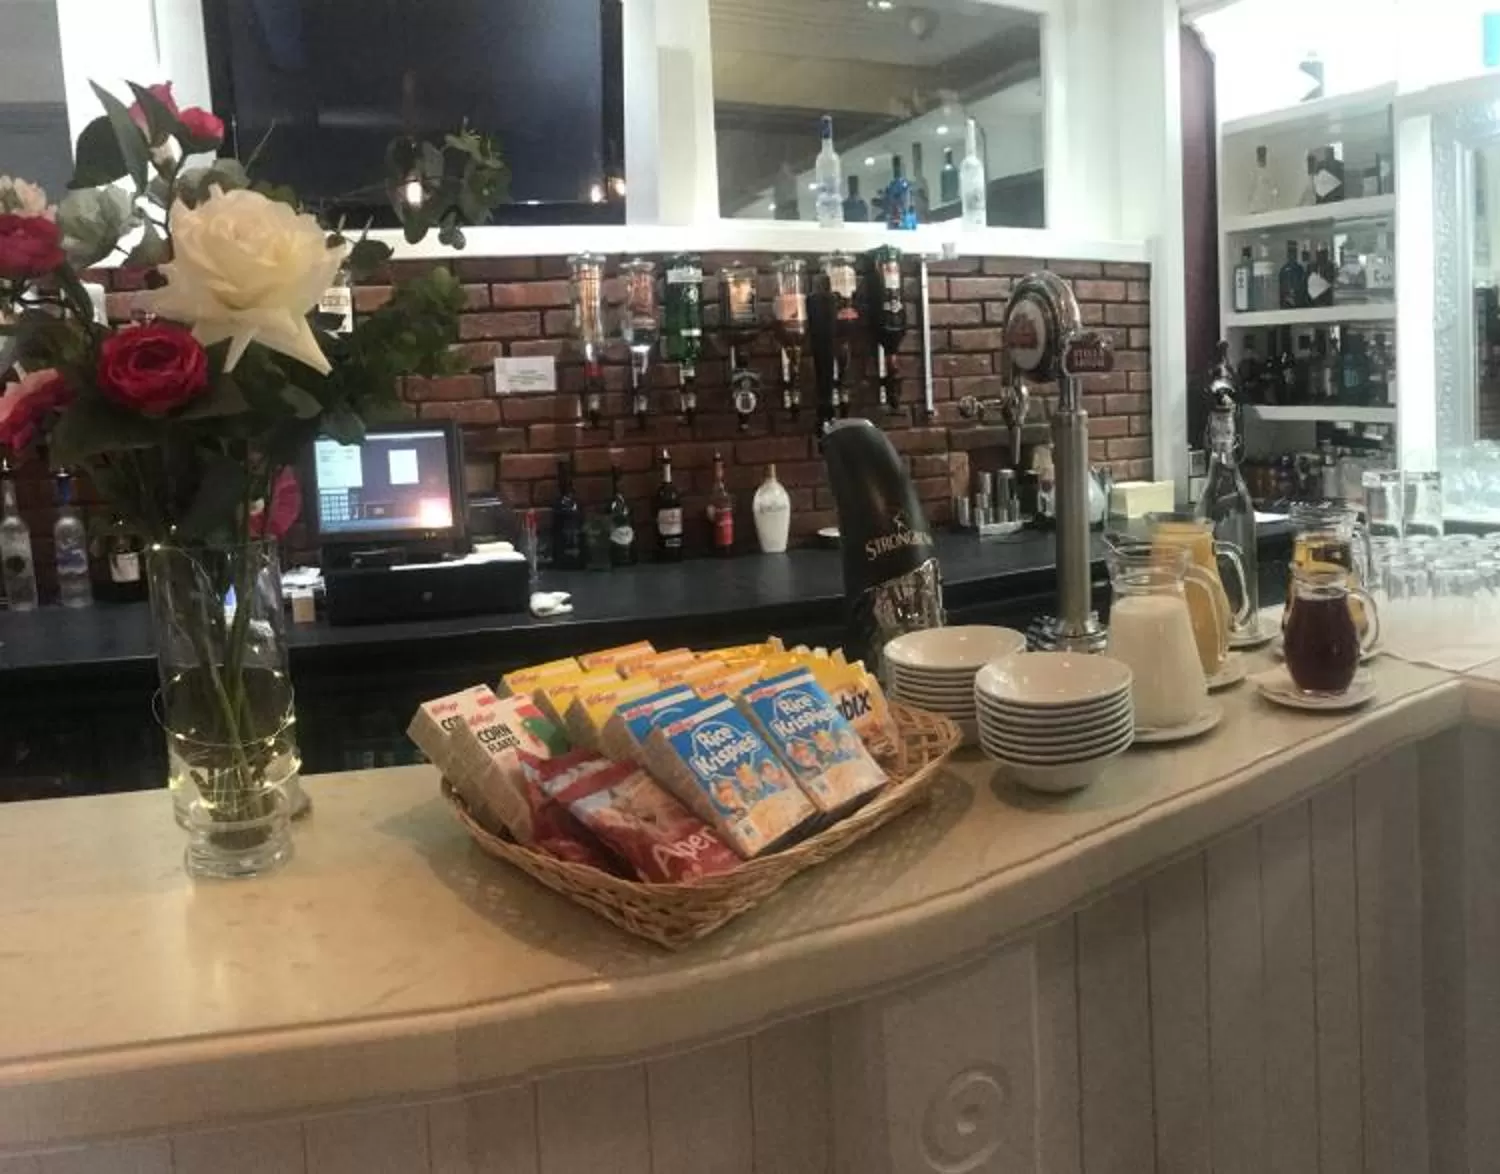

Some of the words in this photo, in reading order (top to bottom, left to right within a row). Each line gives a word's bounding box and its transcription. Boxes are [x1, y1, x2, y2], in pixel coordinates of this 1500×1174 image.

[777, 694, 812, 714] Rice
[771, 705, 836, 737] Krispies
[477, 722, 513, 743] CORN
[695, 726, 732, 748] Rice
[692, 733, 758, 777] Krispies
